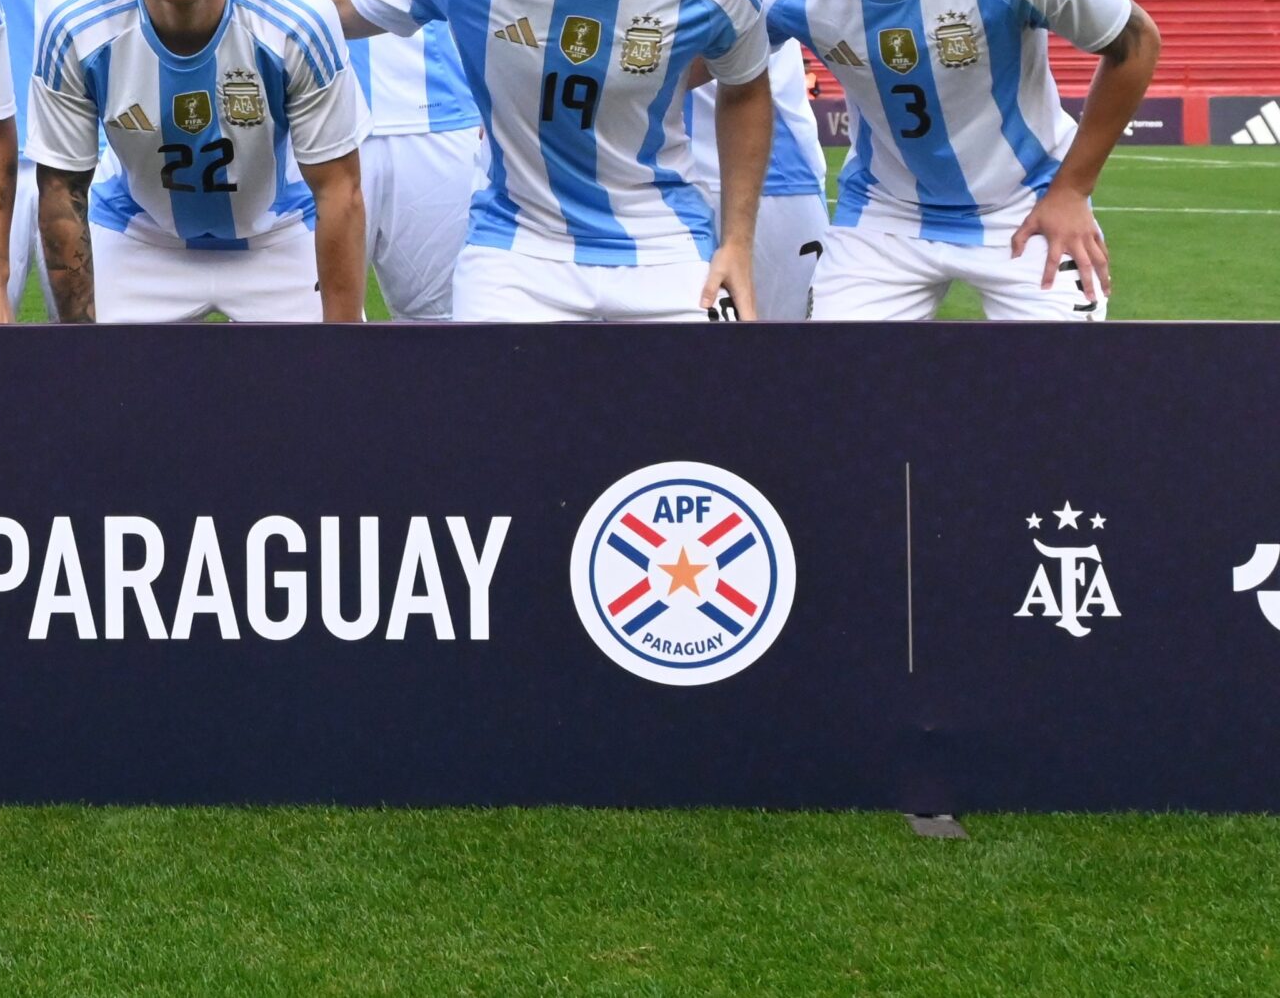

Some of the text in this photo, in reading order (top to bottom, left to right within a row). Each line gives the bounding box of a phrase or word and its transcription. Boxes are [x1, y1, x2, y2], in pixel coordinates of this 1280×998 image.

[631, 41, 652, 61] AFA
[947, 36, 969, 56] AFA
[233, 95, 255, 114] AFA
[542, 72, 599, 130] 19
[891, 84, 932, 138] 3
[827, 111, 849, 136] VS
[157, 138, 238, 193] 22
[652, 495, 712, 524] APF
[1013, 538, 1122, 638] AFA
[642, 631, 724, 656] PARAGUAY
